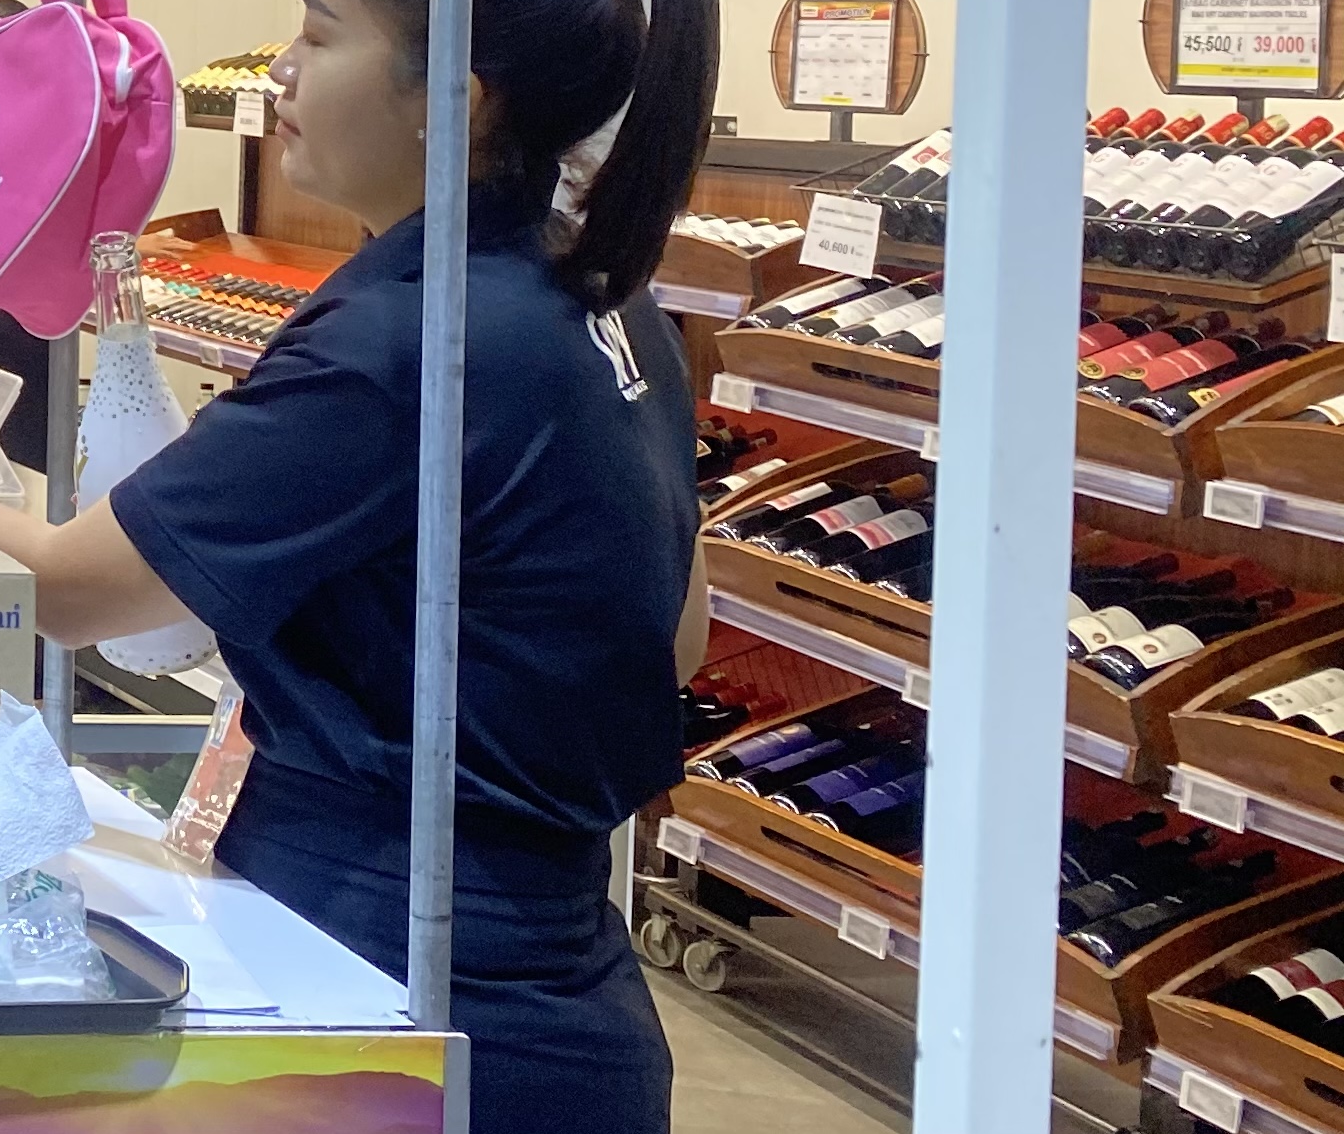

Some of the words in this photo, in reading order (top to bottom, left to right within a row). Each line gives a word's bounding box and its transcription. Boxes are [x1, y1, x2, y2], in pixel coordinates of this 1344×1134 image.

[824, 8, 870, 18] PROMOTION
[1184, 35, 1232, 54] 45,500
[1254, 36, 1305, 55] 39,000
